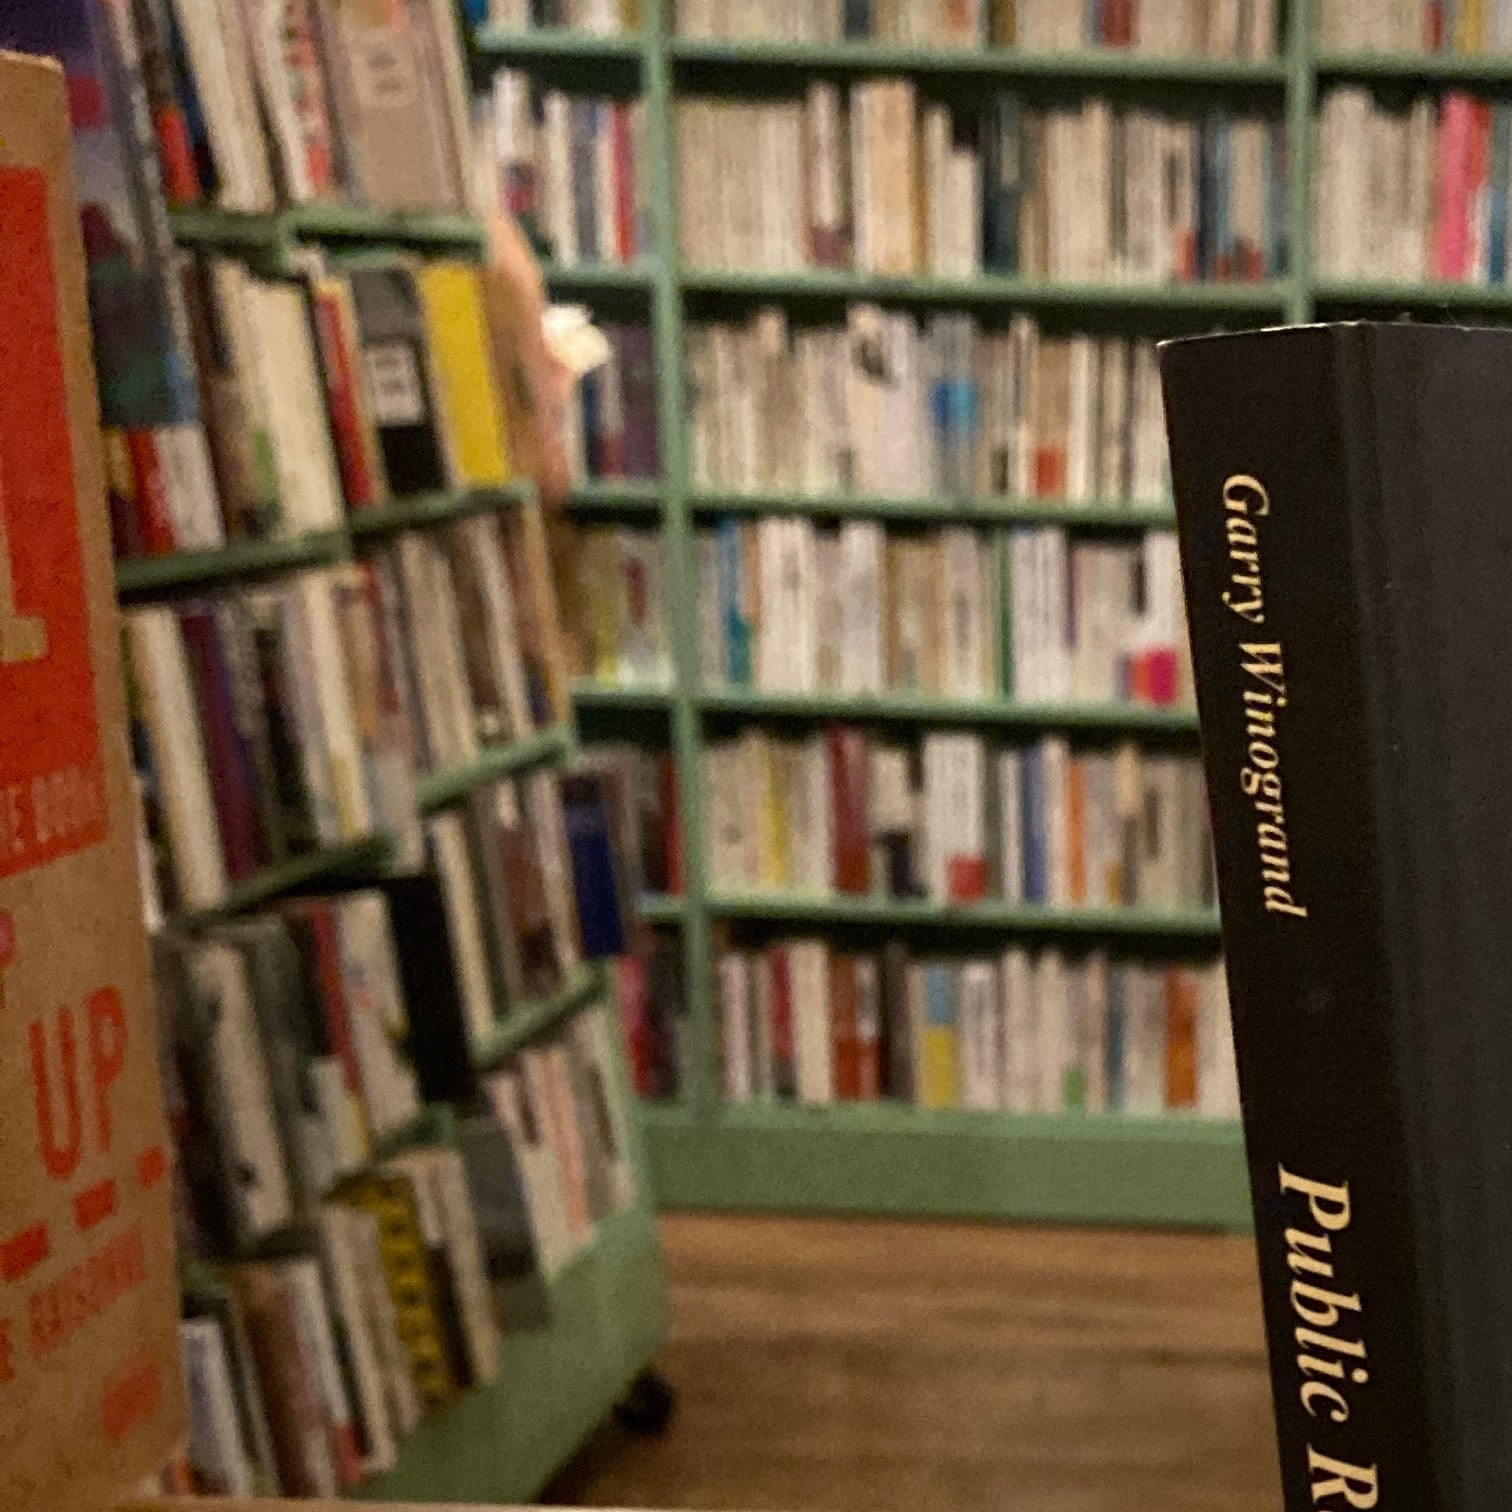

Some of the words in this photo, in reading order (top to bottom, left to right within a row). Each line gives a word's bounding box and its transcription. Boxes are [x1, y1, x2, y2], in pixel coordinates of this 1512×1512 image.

[1222, 474, 1270, 625] Garry
[1238, 641, 1308, 918] Winogrand
[28, 985, 127, 1181] UP
[1278, 1163, 1370, 1424] Public
